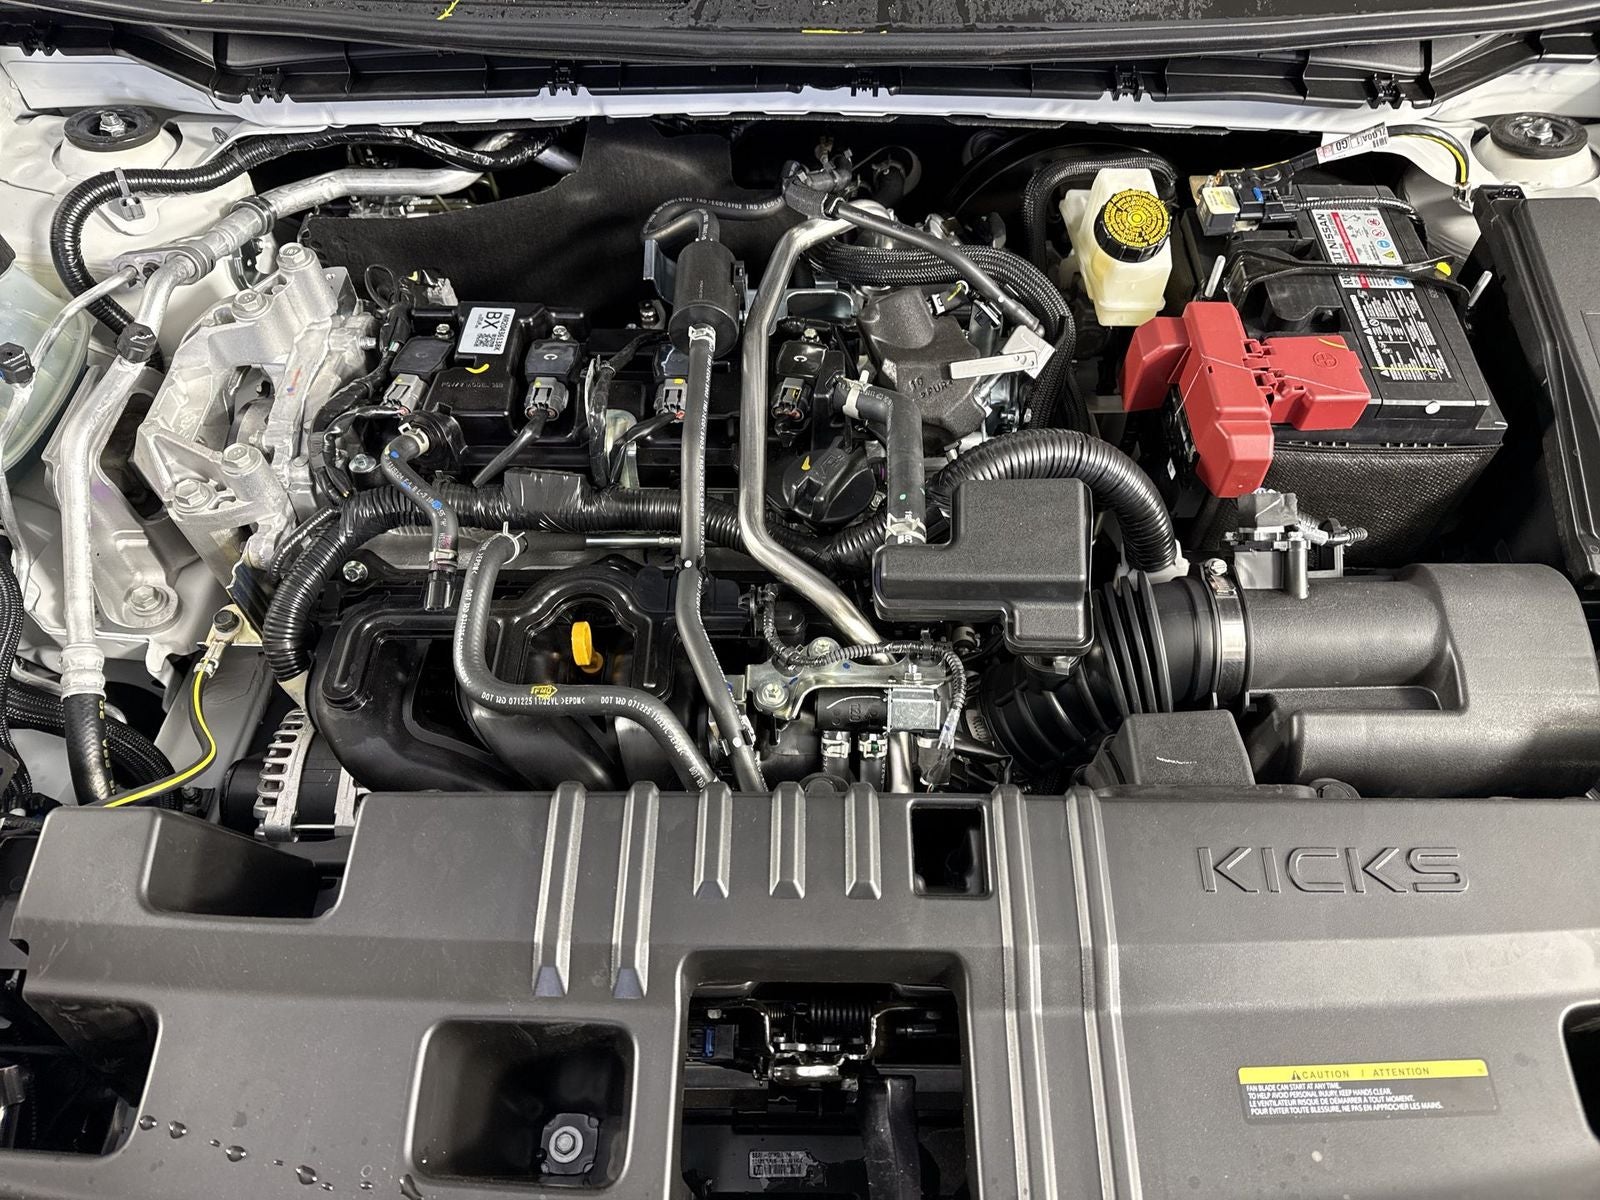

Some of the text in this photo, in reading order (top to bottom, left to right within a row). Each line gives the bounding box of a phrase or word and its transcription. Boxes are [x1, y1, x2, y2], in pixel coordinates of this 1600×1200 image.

[1316, 213, 1338, 250] NISSAN
[482, 311, 503, 329] BX
[481, 691, 494, 702] DOT
[508, 696, 533, 705] 071225
[600, 696, 613, 704] DOT
[627, 699, 652, 715] 071225
[1197, 847, 1469, 894] KICKS
[1302, 1070, 1350, 1079] CAUTION
[1373, 1067, 1430, 1077] ATTENTION
[1248, 1092, 1257, 1100] TO
[1290, 1091, 1318, 1099] PERSONAL
[1352, 1088, 1373, 1096] HANDS
[1258, 1084, 1276, 1092] BLADE
[1289, 1083, 1306, 1091] START
[1257, 1099, 1297, 1107] VENTILATEUR
[1298, 1098, 1320, 1106] RISQUE
[1369, 1095, 1385, 1103] TOUT
[1250, 1107, 1268, 1115] POUR
[1289, 1106, 1310, 1114] TOUTE
[1342, 1104, 1351, 1112] NE
[1351, 1104, 1363, 1112] PAS
[1373, 1102, 1409, 1111] APPROCHER
[1410, 1102, 1420, 1110] LES
